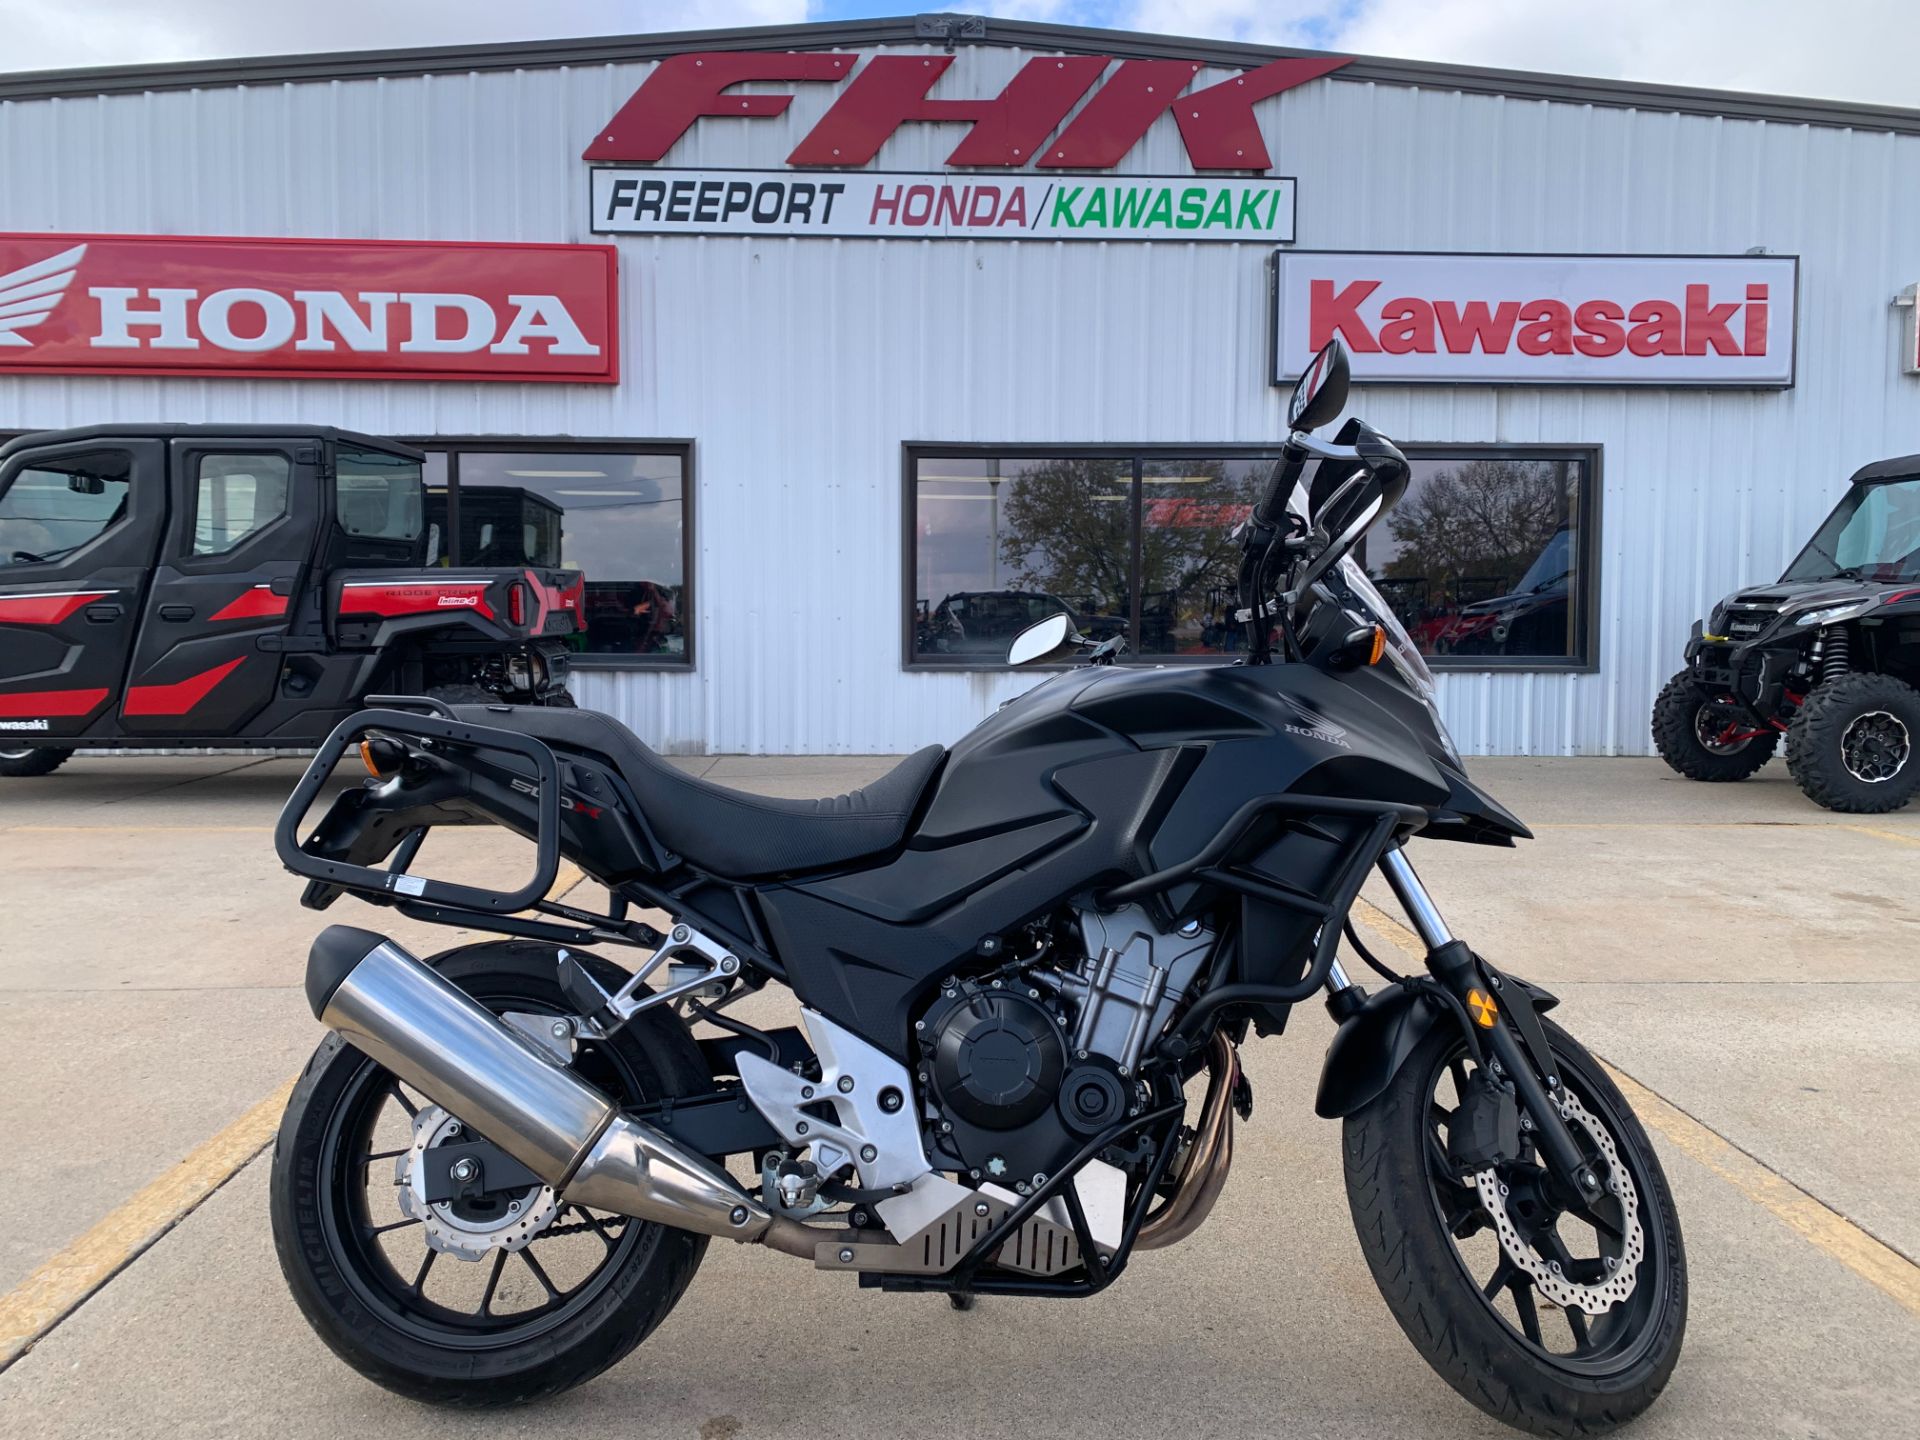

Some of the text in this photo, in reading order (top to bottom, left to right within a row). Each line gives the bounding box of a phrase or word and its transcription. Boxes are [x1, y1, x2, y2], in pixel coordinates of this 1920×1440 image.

[582, 52, 1354, 169] FHK
[607, 179, 846, 225] FREEPORT
[88, 286, 601, 356] HONDA
[1309, 279, 1769, 357] Kawasaki
[1284, 723, 1353, 750] HONDA
